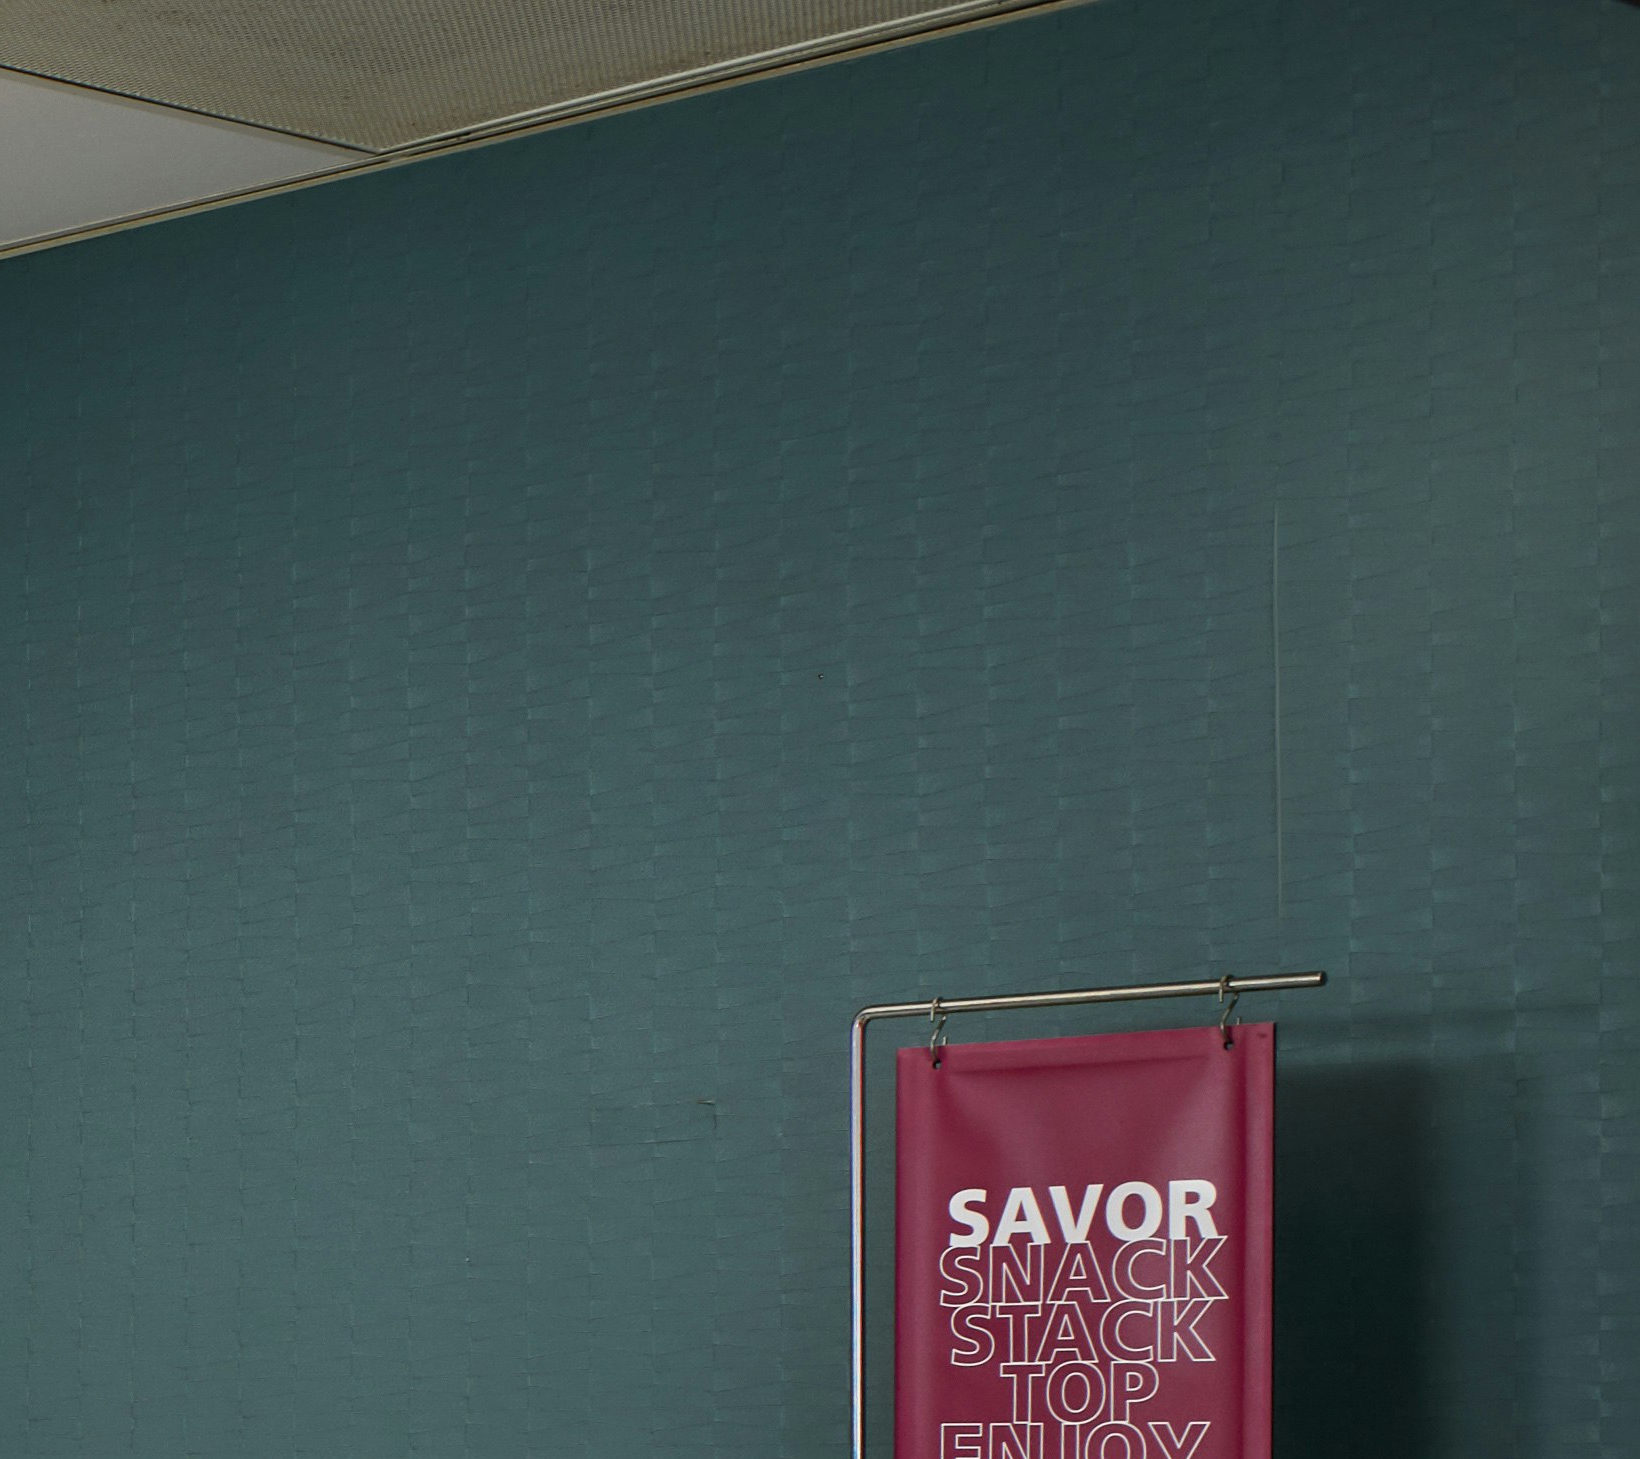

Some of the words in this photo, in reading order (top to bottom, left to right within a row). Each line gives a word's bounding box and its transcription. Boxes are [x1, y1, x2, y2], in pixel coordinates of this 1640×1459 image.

[948, 1179, 1219, 1247] SAVOR
[939, 1235, 1230, 1308] SNACK
[950, 1297, 1217, 1366] STACK
[1000, 1360, 1160, 1425] TOP
